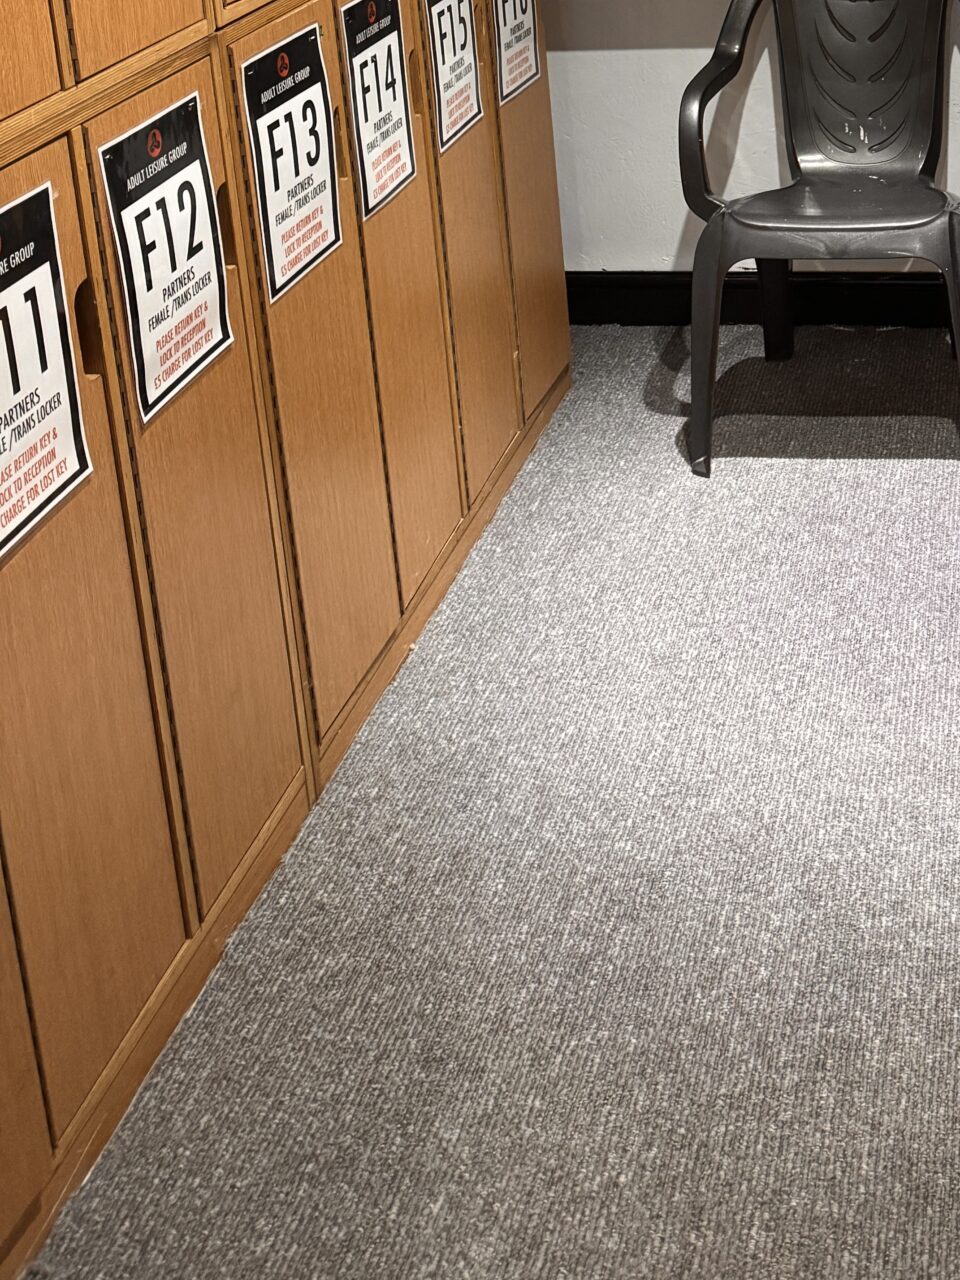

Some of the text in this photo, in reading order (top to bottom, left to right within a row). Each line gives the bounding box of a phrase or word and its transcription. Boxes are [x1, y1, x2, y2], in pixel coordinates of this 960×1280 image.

[260, 65, 311, 105] ADULT LEISURE GROUP
[359, 44, 396, 123] F14
[126, 141, 188, 192] ADULT LEISURE GROUP
[266, 99, 321, 193] F13
[275, 204, 293, 227] FEMALE
[310, 179, 327, 201] LOCKER
[286, 173, 314, 203] PARTNERS
[10, 242, 34, 268] GROUP
[134, 180, 204, 293] F12
[148, 304, 170, 333] FEMALE
[191, 271, 212, 297] LOCKER
[162, 265, 196, 303] PARTNERS
[0, 286, 48, 396] 11
[155, 300, 209, 353] PLEASE RETURN KEY &
[159, 317, 206, 367] LOCK TO RECEPTION
[153, 327, 214, 390] £5 CHARGE FOR LOST KEY
[37, 392, 62, 425] LOCKER
